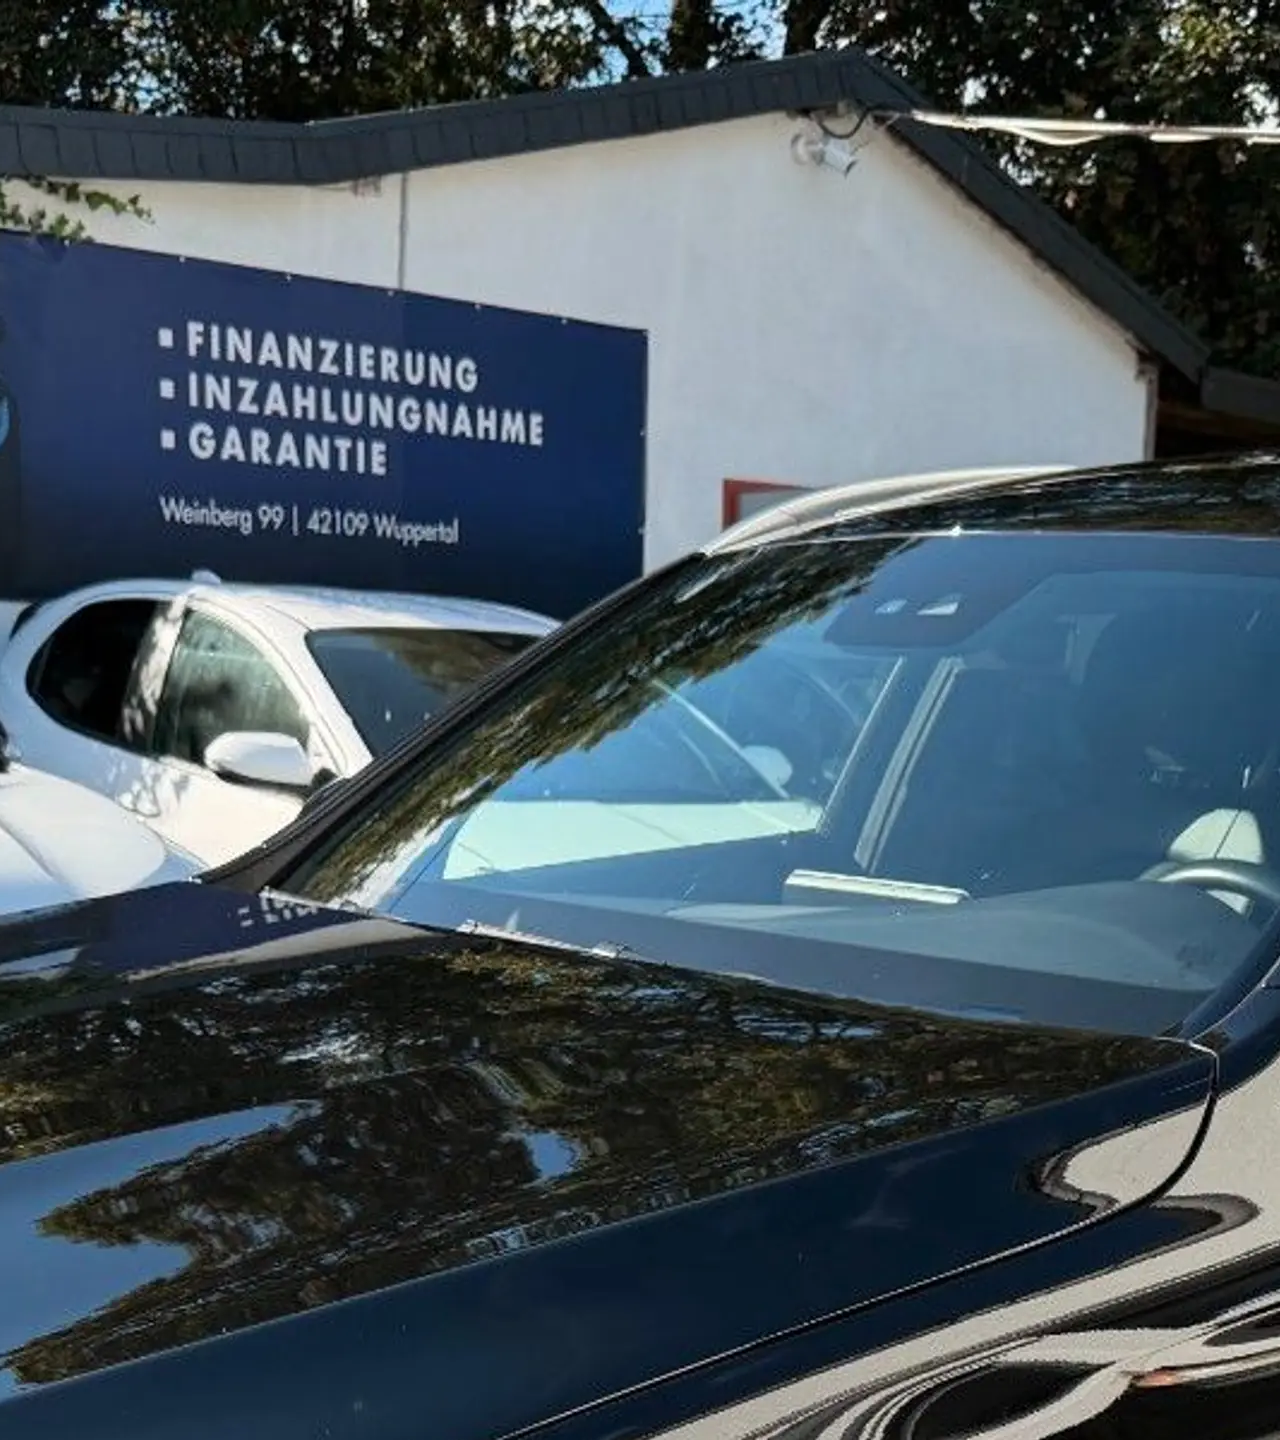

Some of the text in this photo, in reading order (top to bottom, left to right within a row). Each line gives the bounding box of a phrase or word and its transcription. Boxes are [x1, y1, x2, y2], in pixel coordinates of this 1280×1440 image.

[187, 321, 479, 393] FINANZIERUNG
[188, 372, 544, 446] INZAHLUNGNAHME
[188, 422, 388, 476] GARANTIE
[160, 496, 253, 535] Weinberg
[258, 503, 285, 531] 99
[307, 508, 369, 537] 42109
[373, 513, 459, 548] Wuppertal
